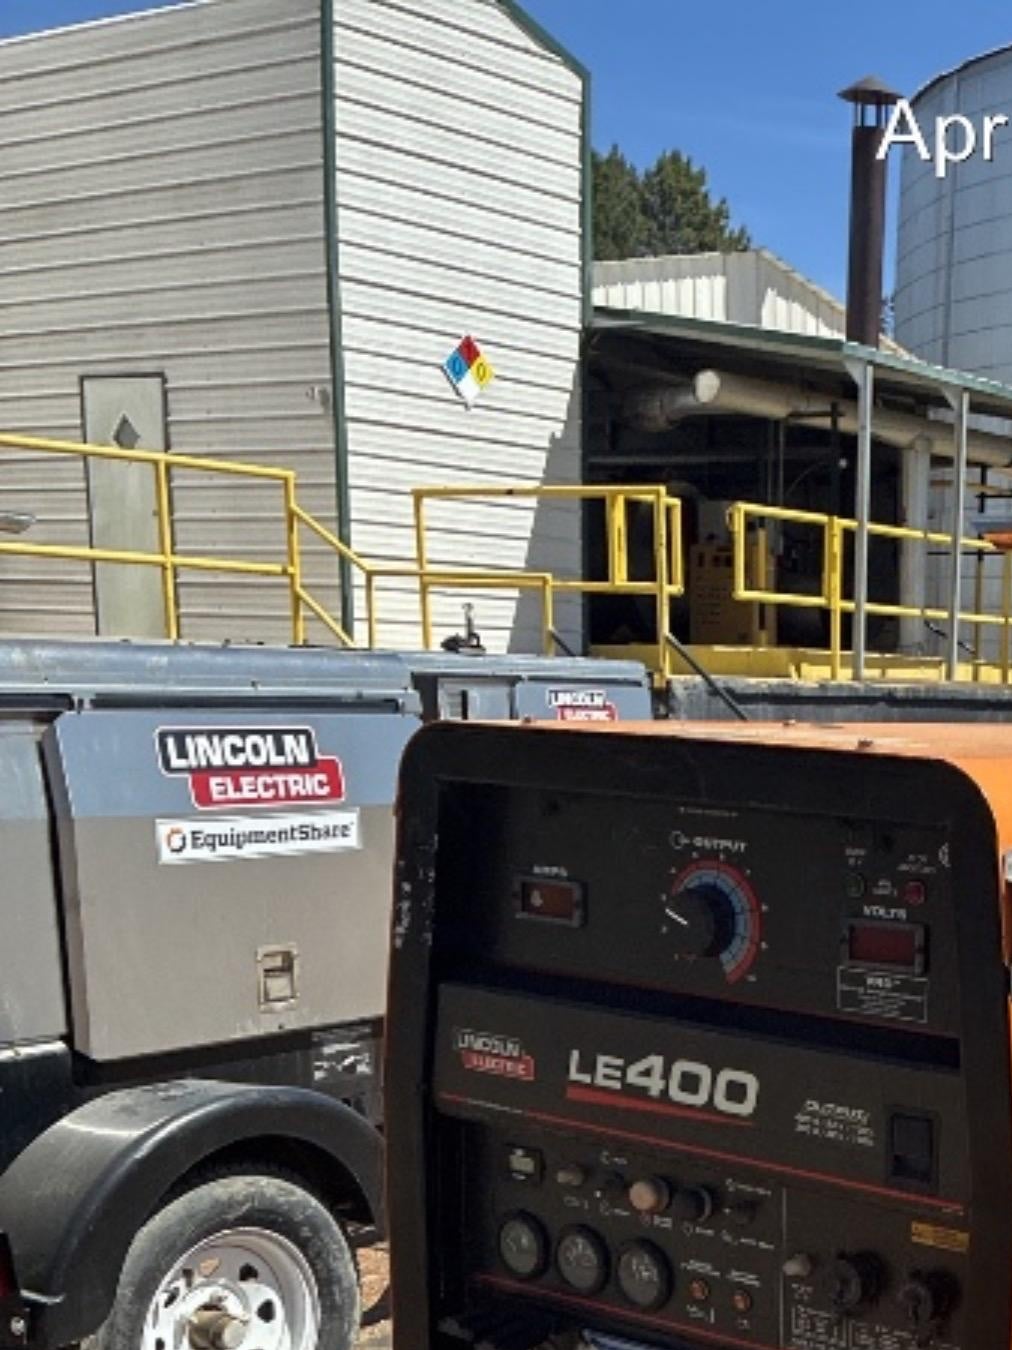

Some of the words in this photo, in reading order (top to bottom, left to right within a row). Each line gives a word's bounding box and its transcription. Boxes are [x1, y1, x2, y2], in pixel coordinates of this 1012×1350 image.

[166, 734, 310, 770] LINCOLN
[208, 772, 331, 801] ELECTRIC
[190, 820, 352, 852] EquipmentShare
[692, 835, 749, 853] OUTPUT
[567, 1049, 760, 1117] LE400
